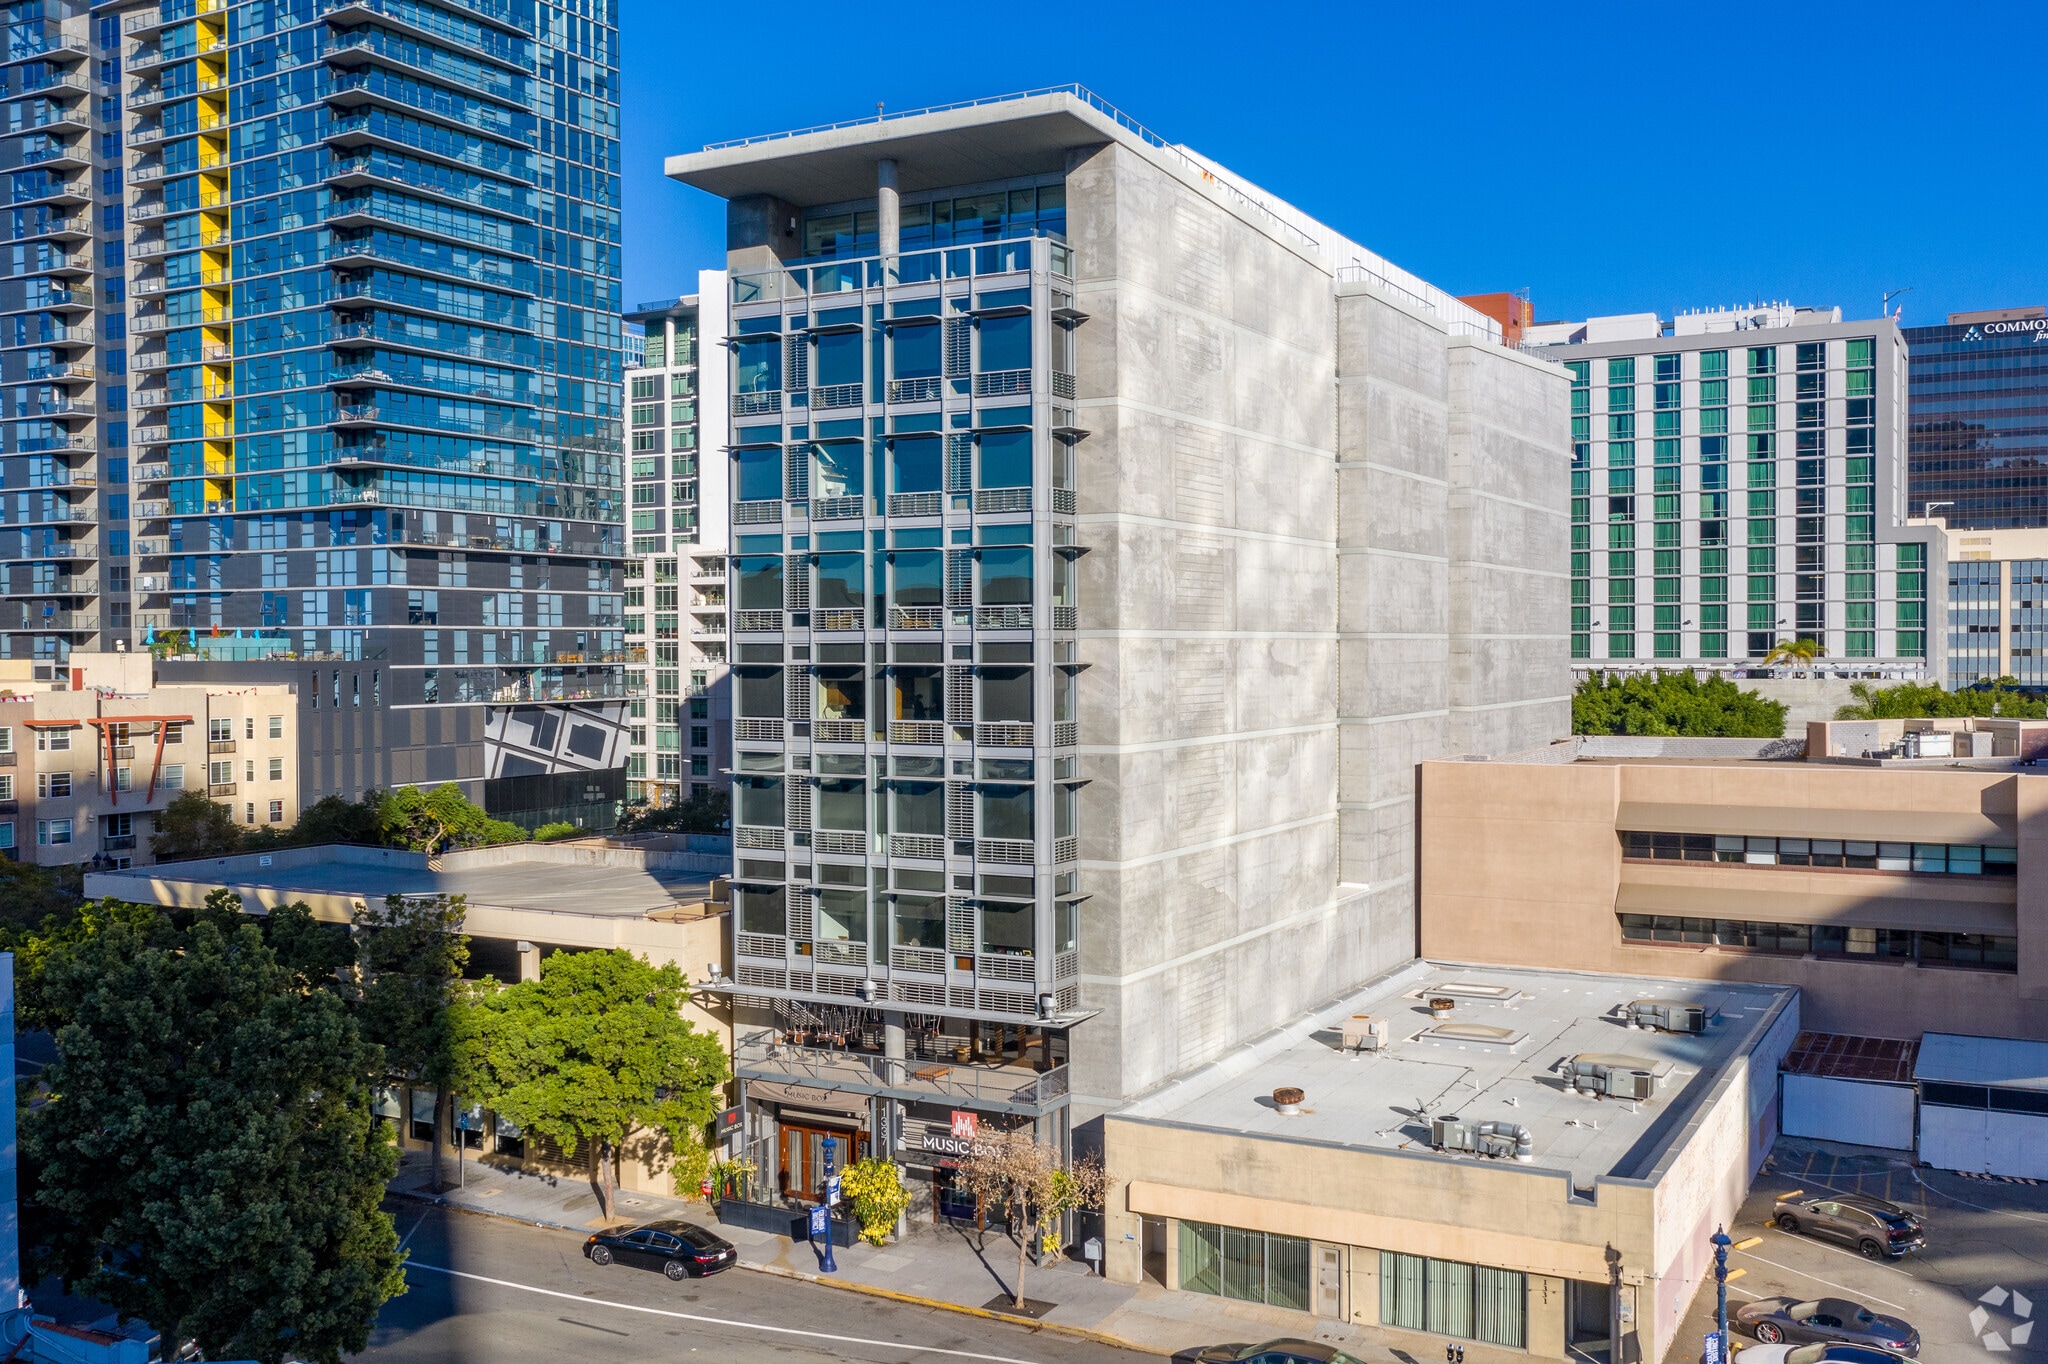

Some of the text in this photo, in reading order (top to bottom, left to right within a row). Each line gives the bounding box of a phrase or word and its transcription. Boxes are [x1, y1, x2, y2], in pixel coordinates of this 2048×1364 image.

[1984, 319, 2048, 334] COMMO
[787, 1091, 809, 1100] MUSIC
[720, 1121, 743, 1134] MUSIC BOX
[880, 1106, 888, 1146] 1337
[923, 1136, 1003, 1160] MUSIC BO
